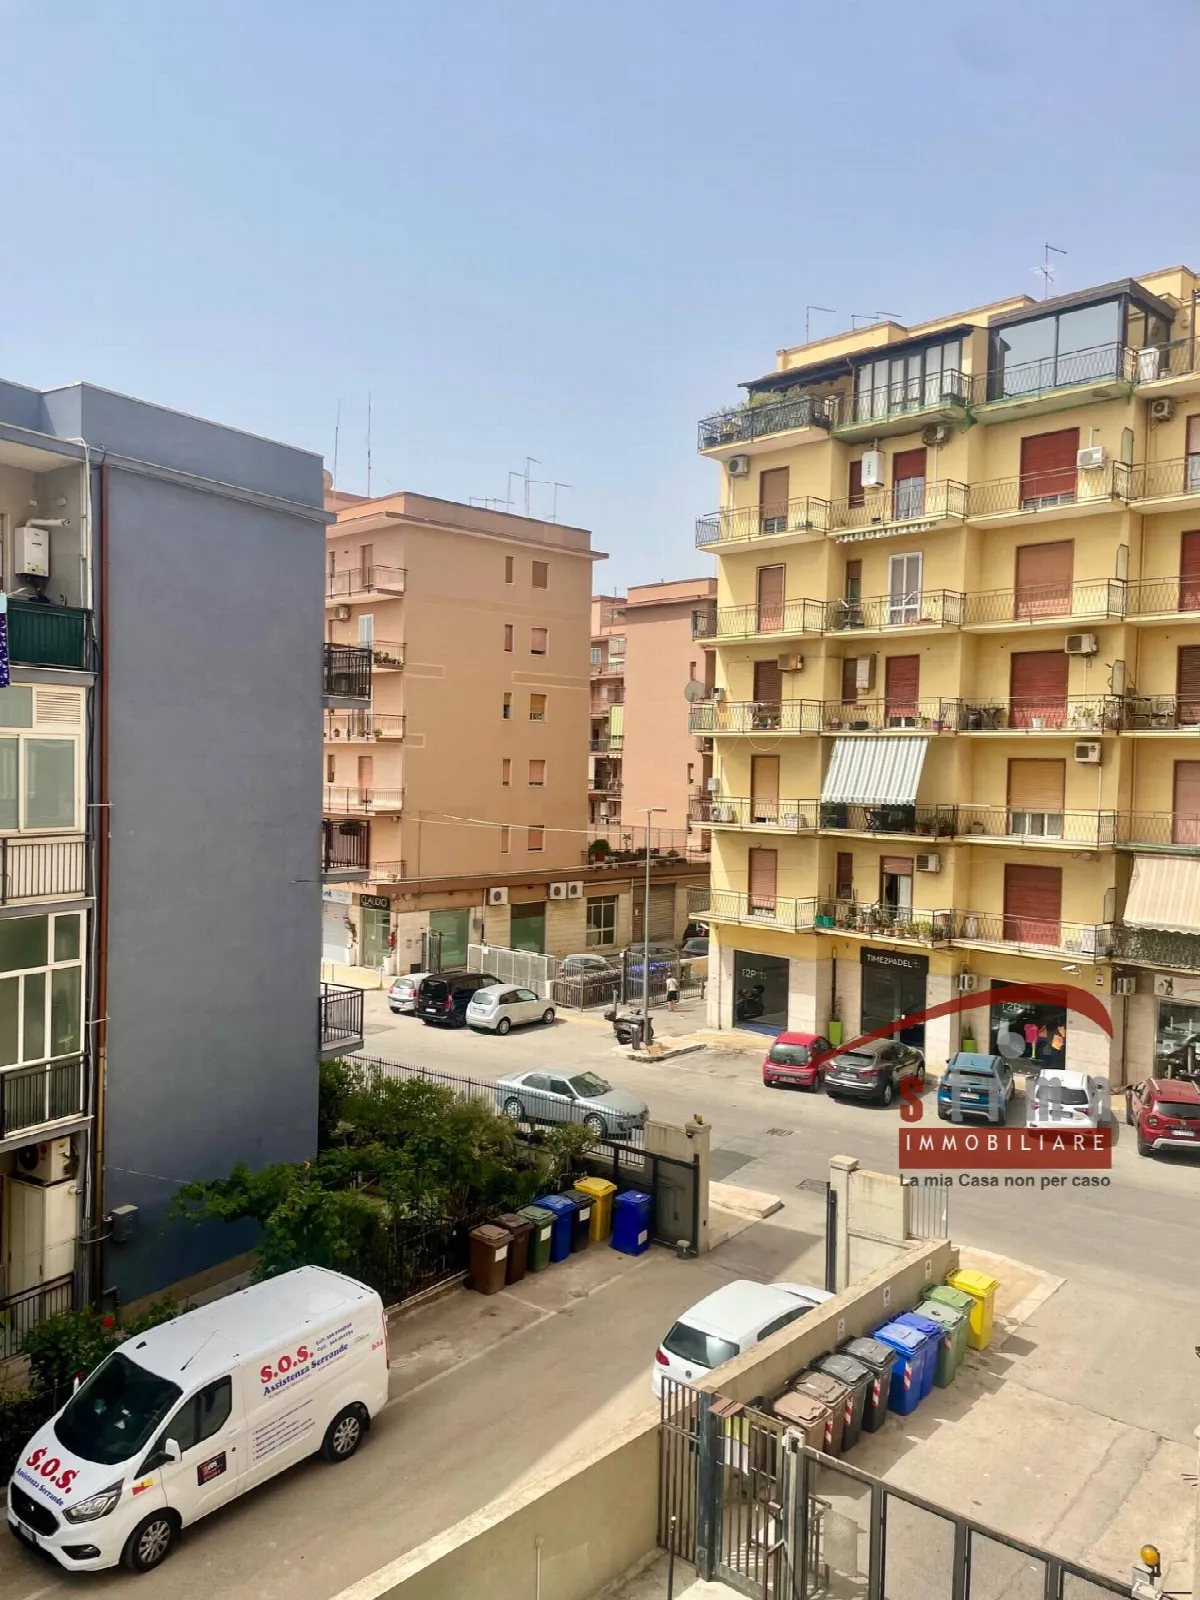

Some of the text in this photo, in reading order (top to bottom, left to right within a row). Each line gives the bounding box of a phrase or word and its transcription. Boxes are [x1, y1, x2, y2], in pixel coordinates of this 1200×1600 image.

[360, 894, 388, 908] CLAUDIO
[742, 968, 757, 979] T2P
[867, 954, 913, 968] TIME2PADEL
[260, 1345, 314, 1384] S.O.S.
[263, 1366, 311, 1396] Assistenza
[311, 1343, 349, 1369] Serrande
[15, 1467, 64, 1507] Assistenza Serrande
[26, 1446, 80, 1494] S.O.S.
